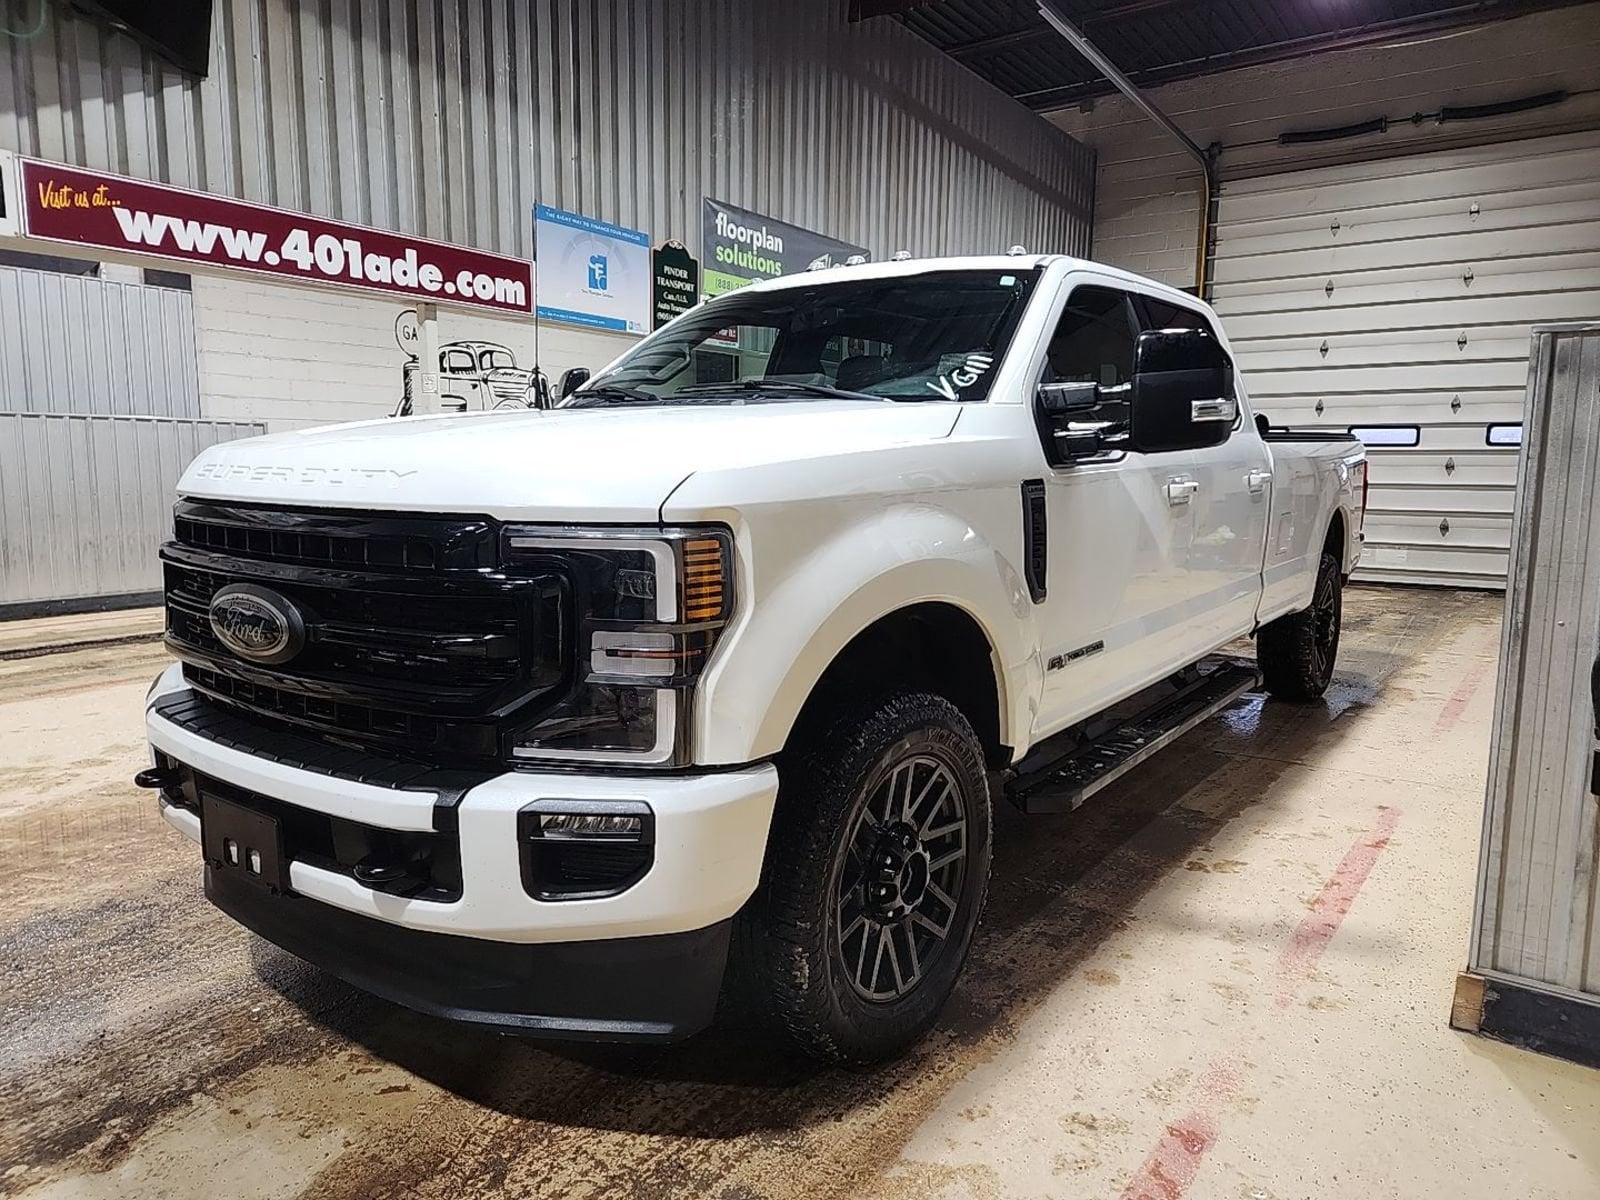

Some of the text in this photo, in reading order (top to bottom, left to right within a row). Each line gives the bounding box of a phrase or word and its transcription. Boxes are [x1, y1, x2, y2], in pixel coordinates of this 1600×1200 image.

[38, 180, 73, 210] Visit
[74, 190, 90, 209] us
[715, 211, 784, 254] floorplan
[112, 207, 526, 306] www.401ade.com
[715, 245, 783, 276] solutions
[656, 276, 695, 292] TRANSPORT
[663, 265, 688, 279] PINDER
[402, 325, 419, 341] GA
[197, 463, 418, 488] SUPER DUTY
[223, 606, 266, 643] Ford
